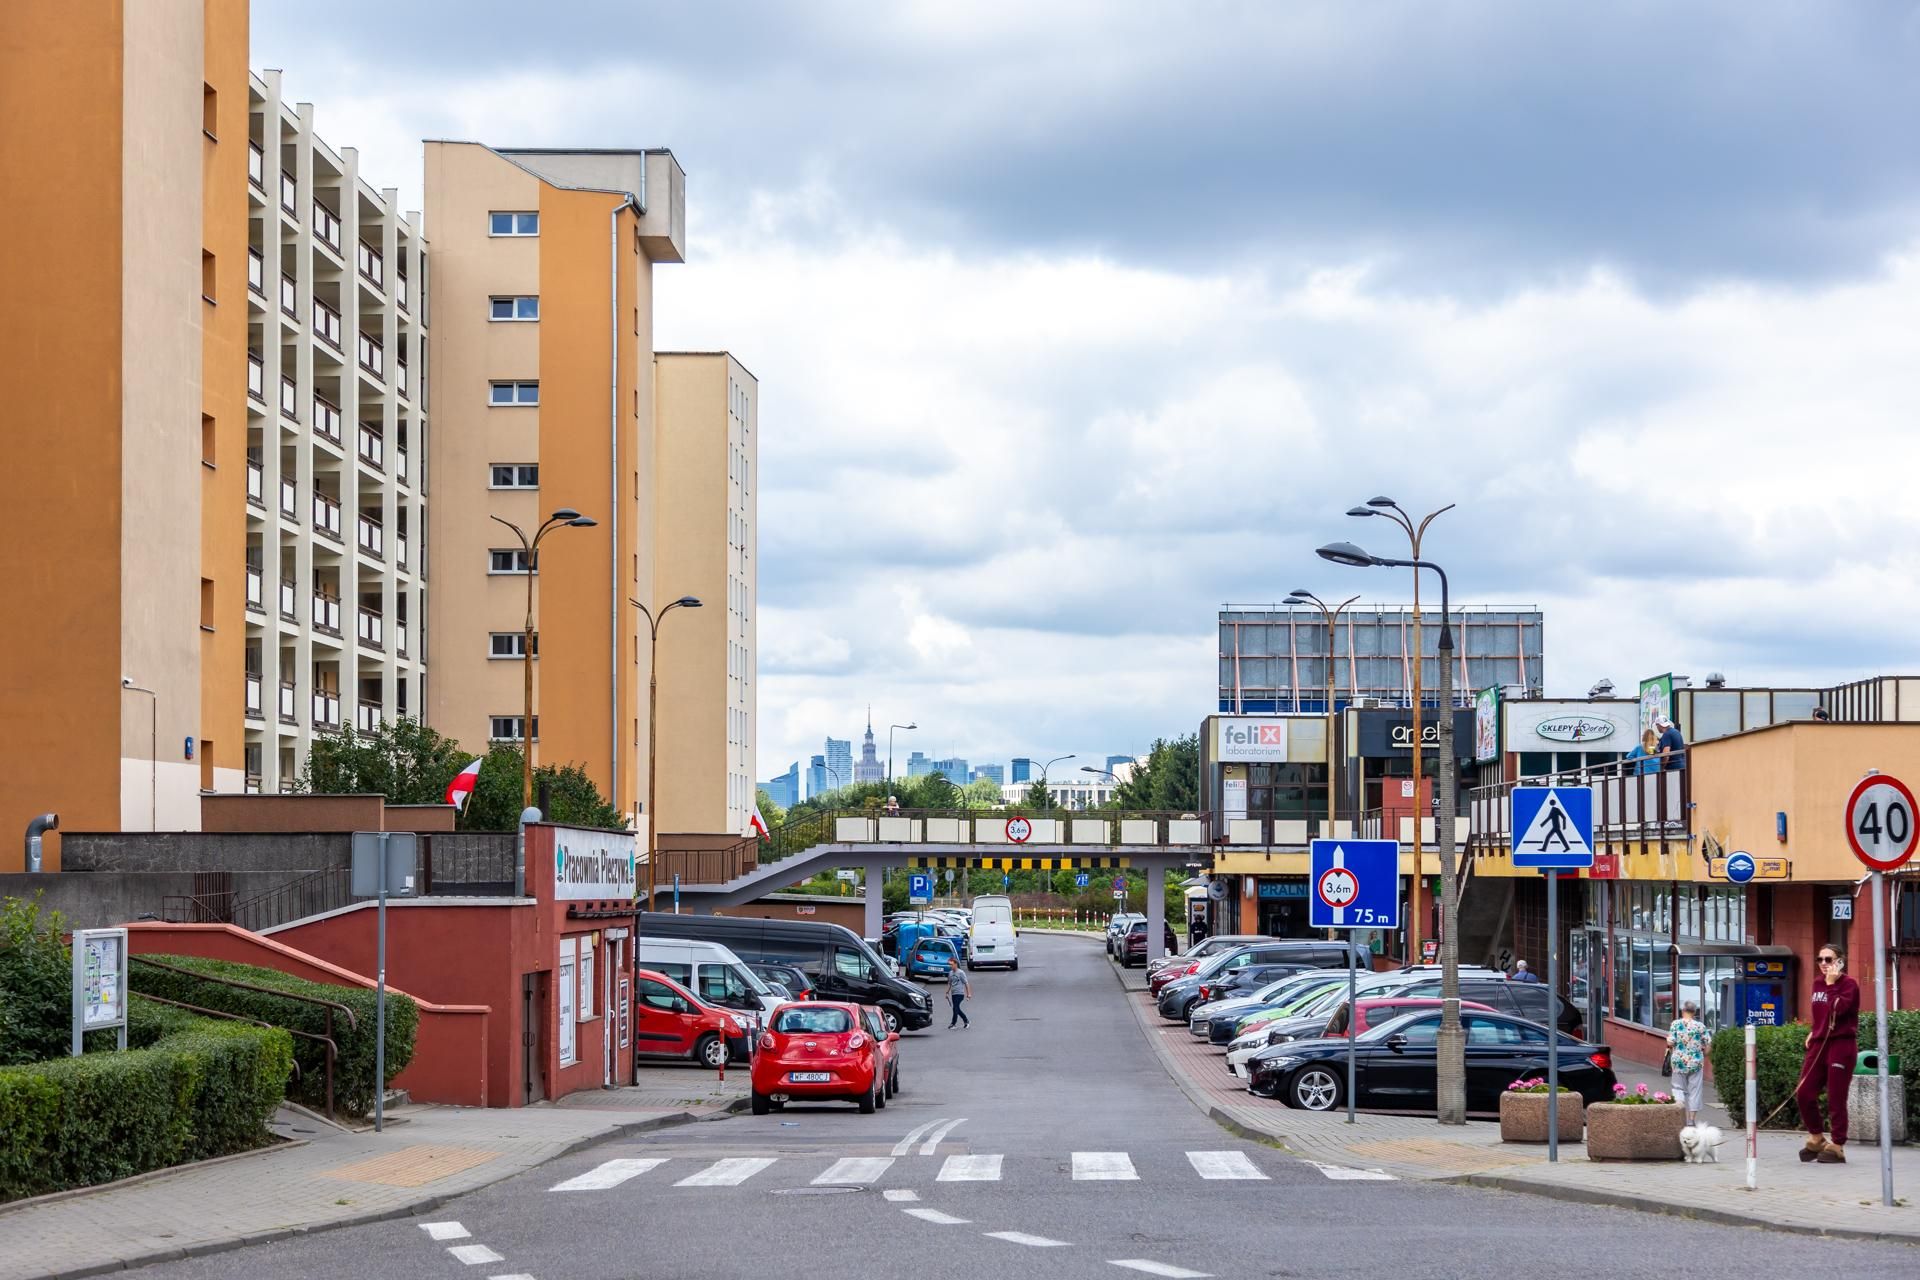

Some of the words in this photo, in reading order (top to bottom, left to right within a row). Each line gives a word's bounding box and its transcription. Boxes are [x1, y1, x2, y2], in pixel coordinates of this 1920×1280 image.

[1225, 745, 1281, 756] laboratorium
[1859, 802, 1908, 845] 40
[564, 846, 600, 884] Pracownia
[601, 849, 629, 894] Pieczywa
[914, 877, 924, 891] P
[1326, 882, 1351, 894] 3,6m
[1354, 908, 1374, 923] 75
[1377, 915, 1389, 924] m
[1834, 905, 1850, 918] 2/4
[1748, 1009, 1775, 1017] banko
[1758, 1017, 1776, 1025] mat
